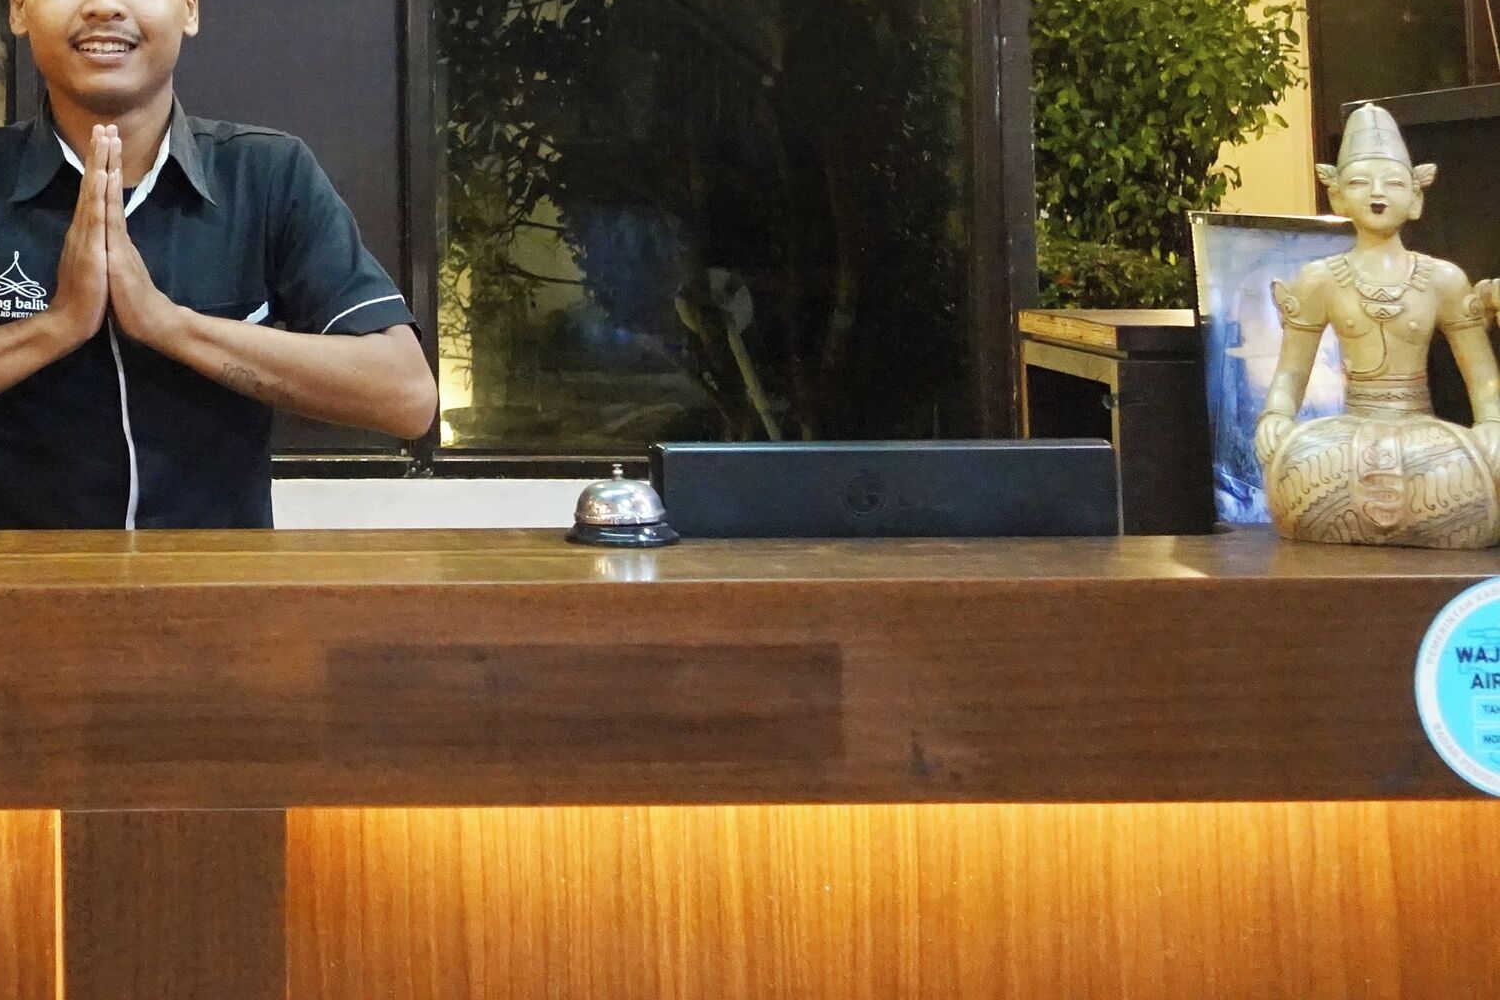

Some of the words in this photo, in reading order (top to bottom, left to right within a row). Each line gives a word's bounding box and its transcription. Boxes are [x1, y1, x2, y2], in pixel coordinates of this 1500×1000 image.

[15, 296, 49, 311] balib
[11, 311, 36, 319] RESTA
[1456, 646, 1500, 664] WAJ
